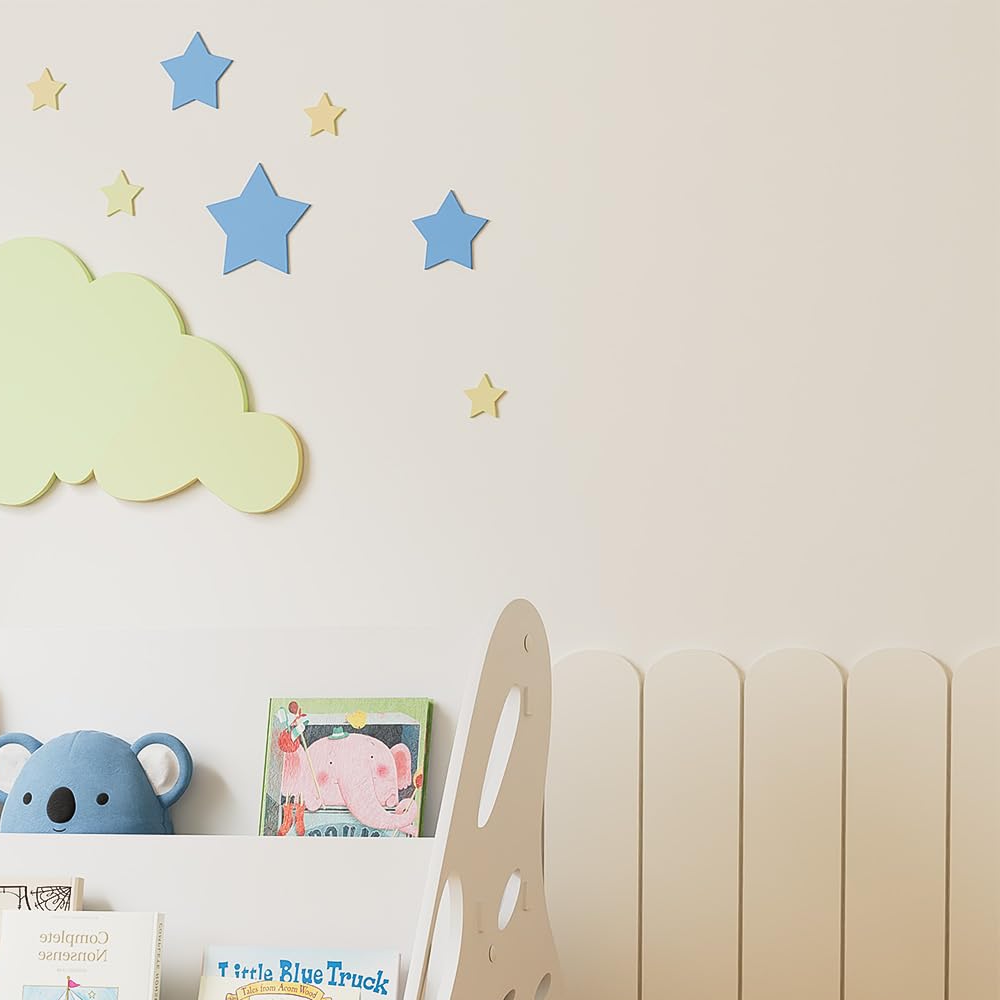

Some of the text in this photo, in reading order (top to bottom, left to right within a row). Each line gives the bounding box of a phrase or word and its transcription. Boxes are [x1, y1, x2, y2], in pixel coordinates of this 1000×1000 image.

[279, 959, 323, 985] Blue
[327, 960, 390, 996] Truck
[241, 987, 258, 996] Tales
[260, 984, 276, 992] from
[300, 984, 318, 999] Wood
